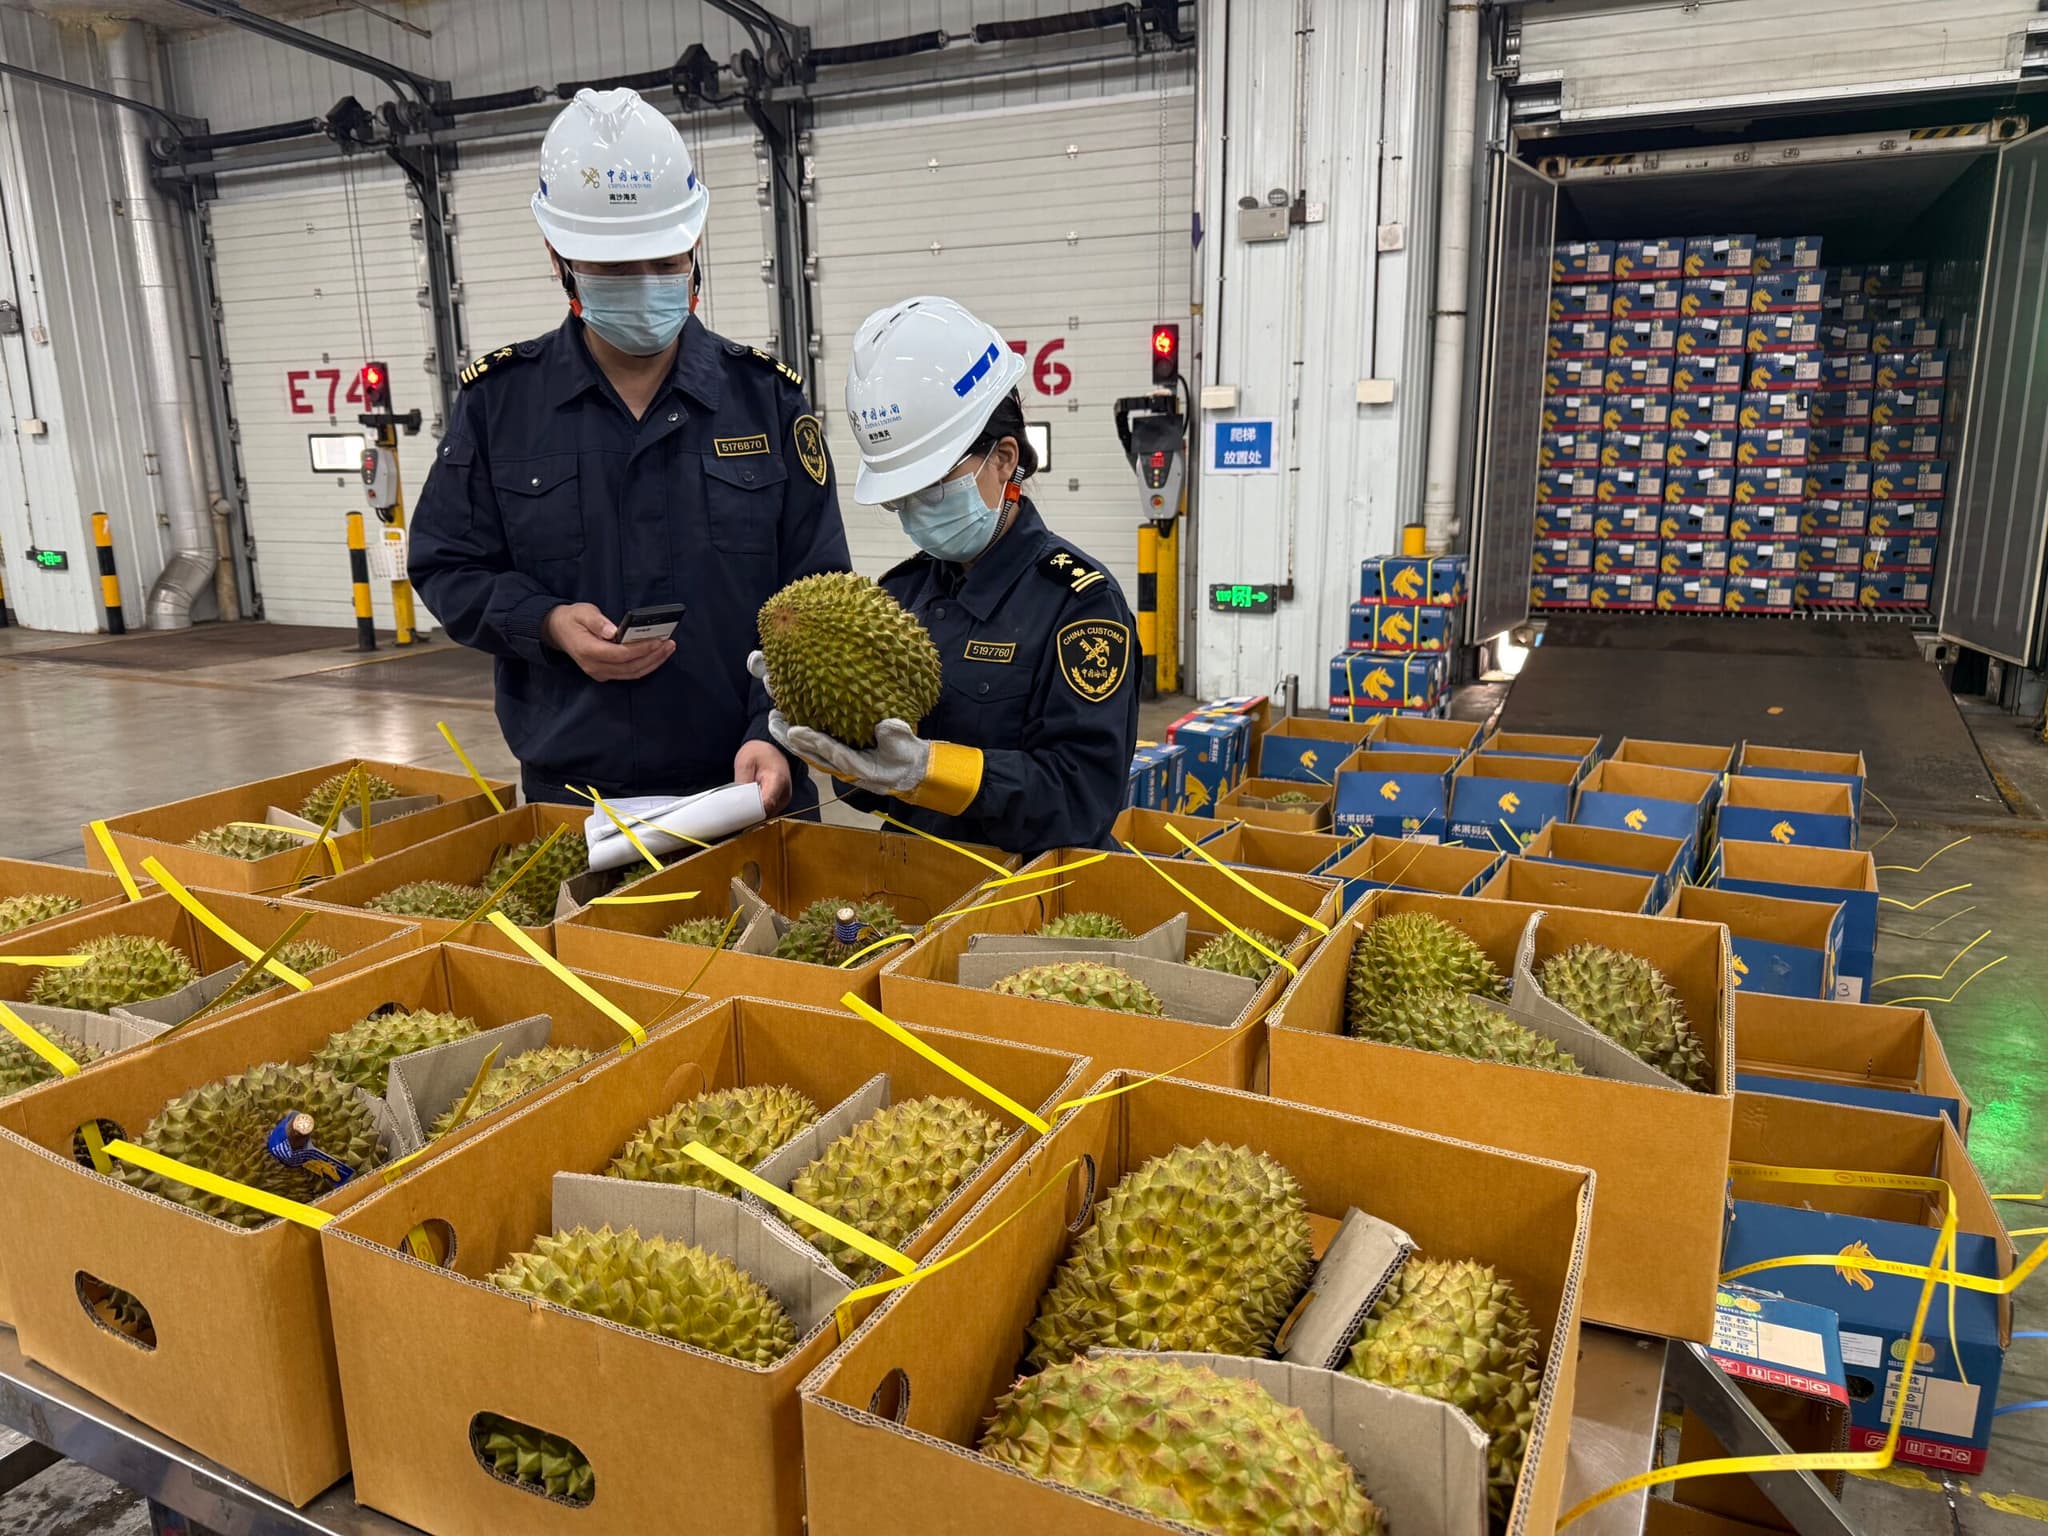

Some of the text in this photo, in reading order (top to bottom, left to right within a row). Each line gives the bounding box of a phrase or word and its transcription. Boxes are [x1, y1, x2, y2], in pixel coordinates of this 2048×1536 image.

[287, 369, 372, 414] E74
[1230, 427, 1257, 442] 爬梯
[721, 440, 762, 452] 5176870
[1223, 450, 1262, 465] 放置处
[1063, 627, 1124, 645] CHINA CUSTOMS
[972, 645, 1010, 657] 5197760
[1336, 813, 1374, 824] 水果码头
[1452, 824, 1490, 836] 水果码头
